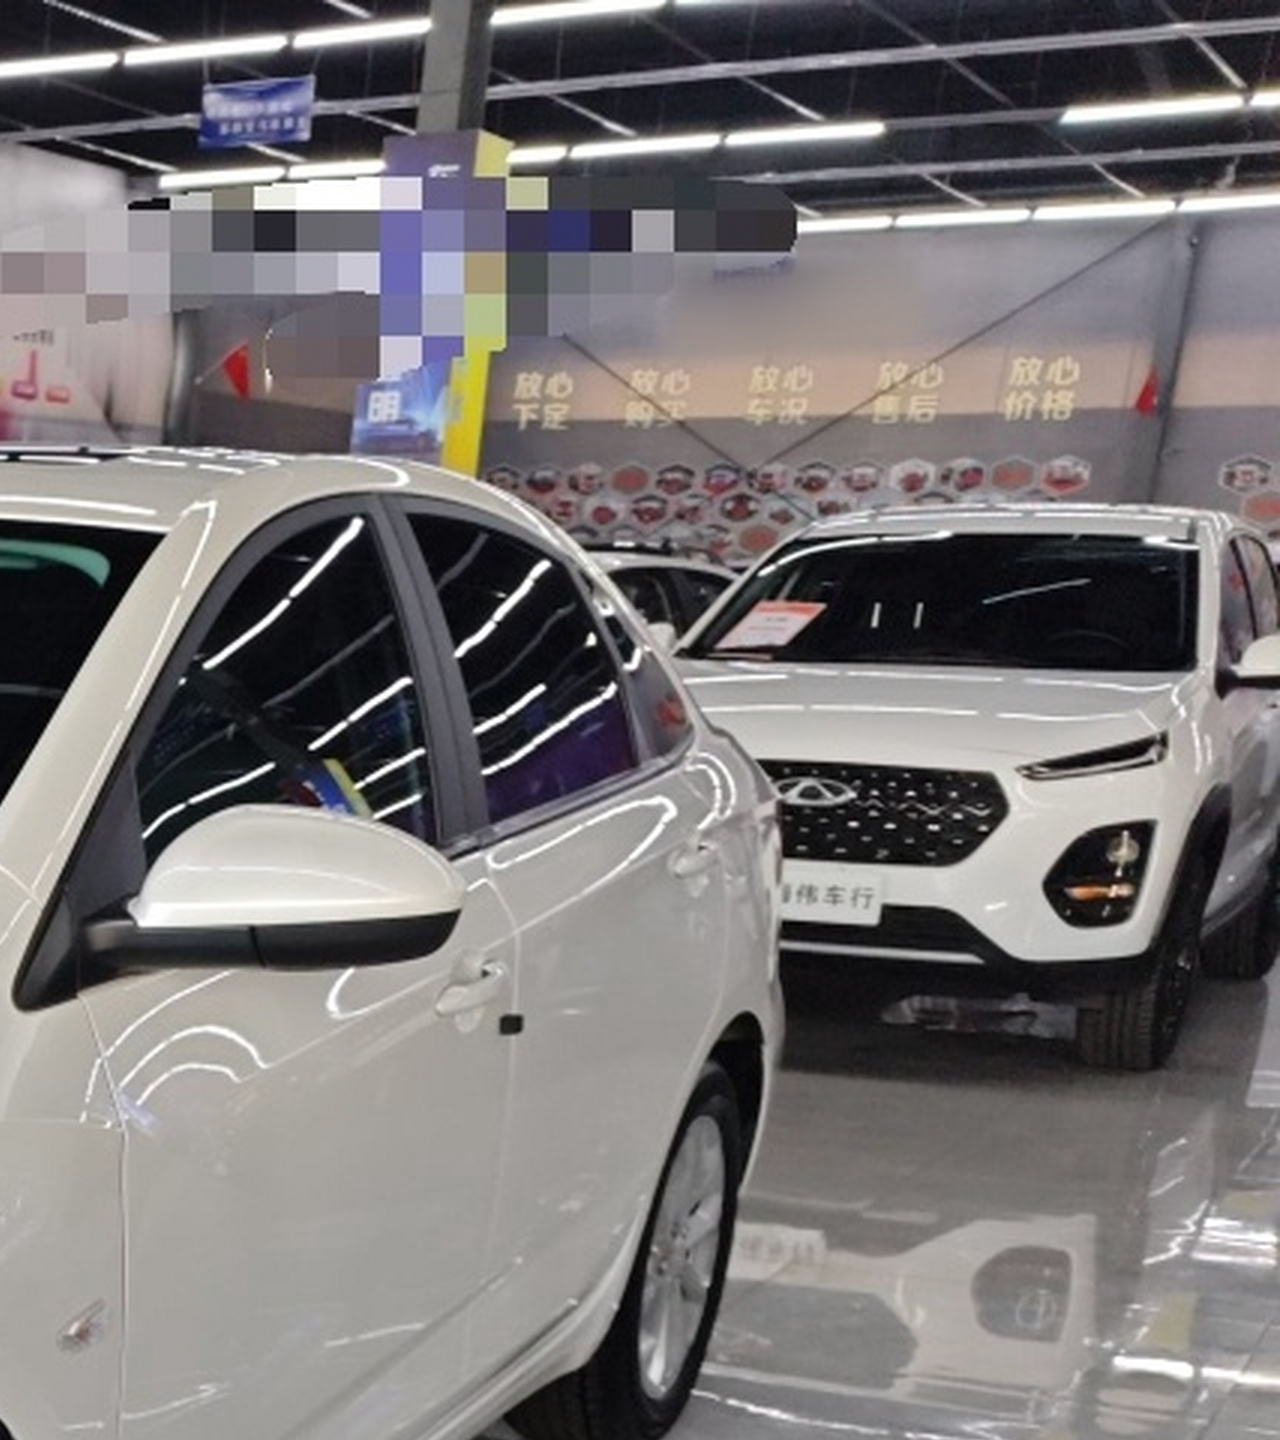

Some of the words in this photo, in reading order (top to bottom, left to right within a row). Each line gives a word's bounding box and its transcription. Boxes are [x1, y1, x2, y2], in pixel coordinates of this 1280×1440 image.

[514, 371, 574, 399] 放心
[629, 368, 690, 396] 放心
[747, 364, 813, 393] 放心
[877, 362, 945, 389] 放心
[1010, 355, 1080, 386] 放心
[745, 396, 809, 426] 车况
[872, 394, 939, 425] 售后
[1004, 389, 1075, 421] 价格
